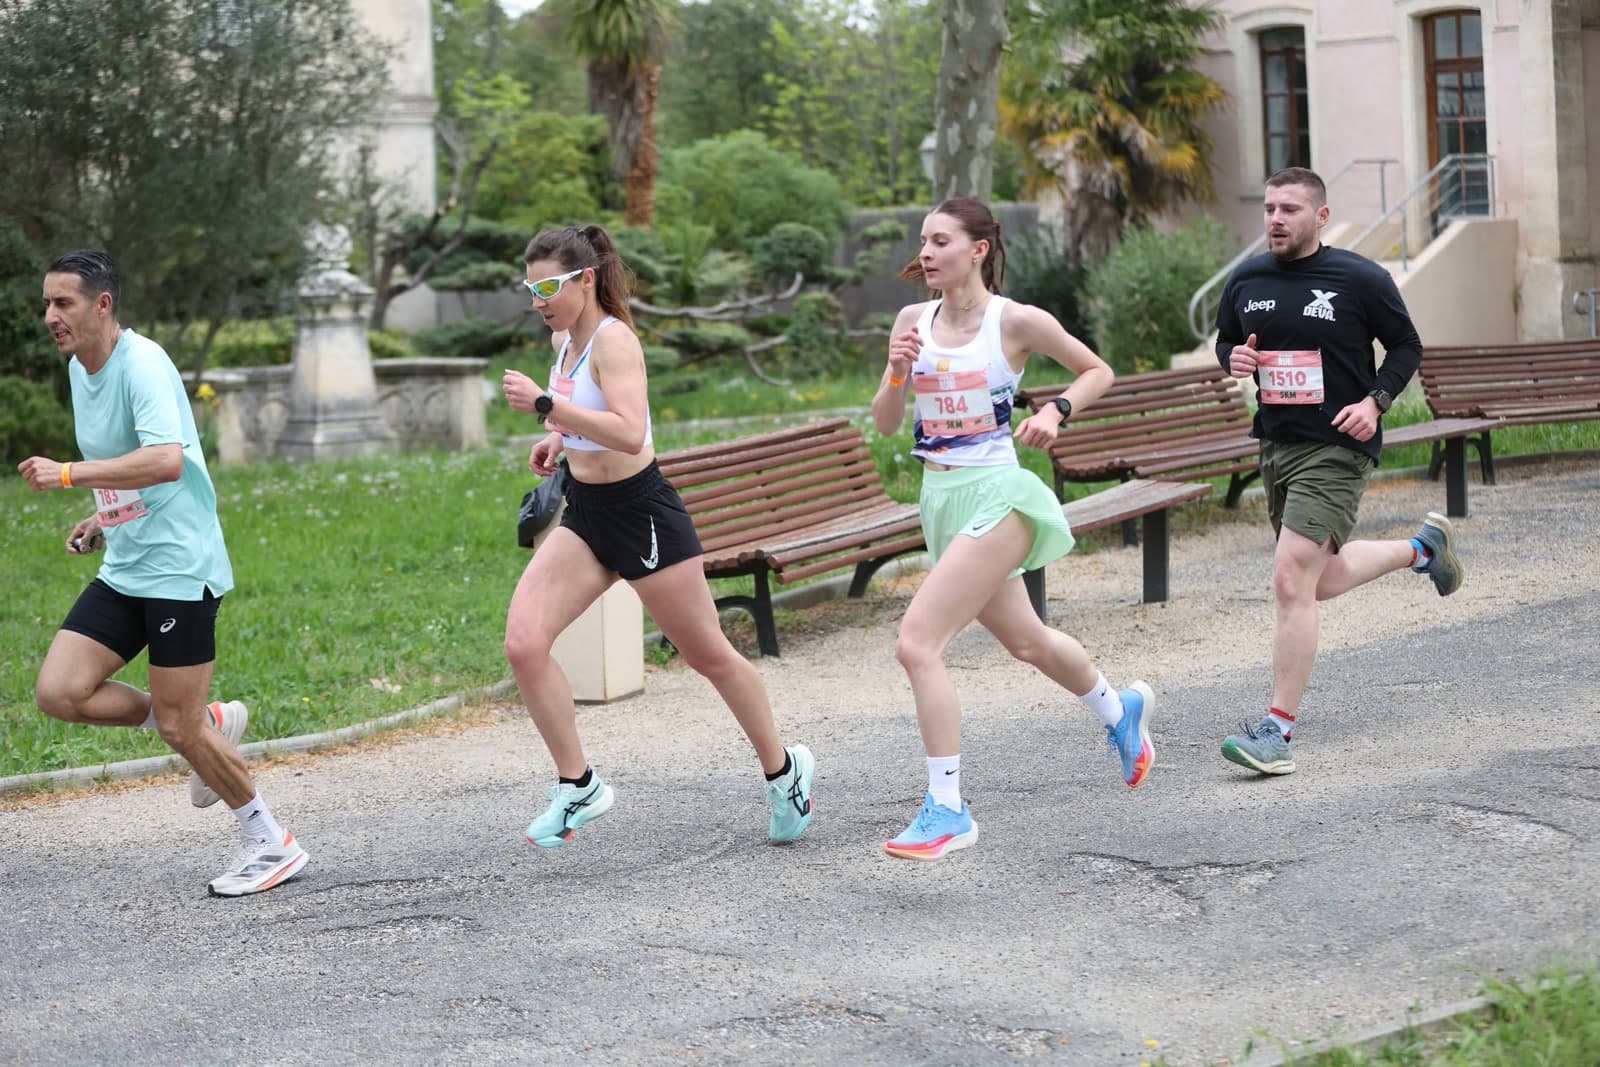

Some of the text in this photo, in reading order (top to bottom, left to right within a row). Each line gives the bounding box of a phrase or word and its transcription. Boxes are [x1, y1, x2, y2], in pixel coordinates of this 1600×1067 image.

[1243, 299, 1276, 313] Jeep
[1268, 370, 1306, 387] 1510
[934, 395, 968, 414] 784
